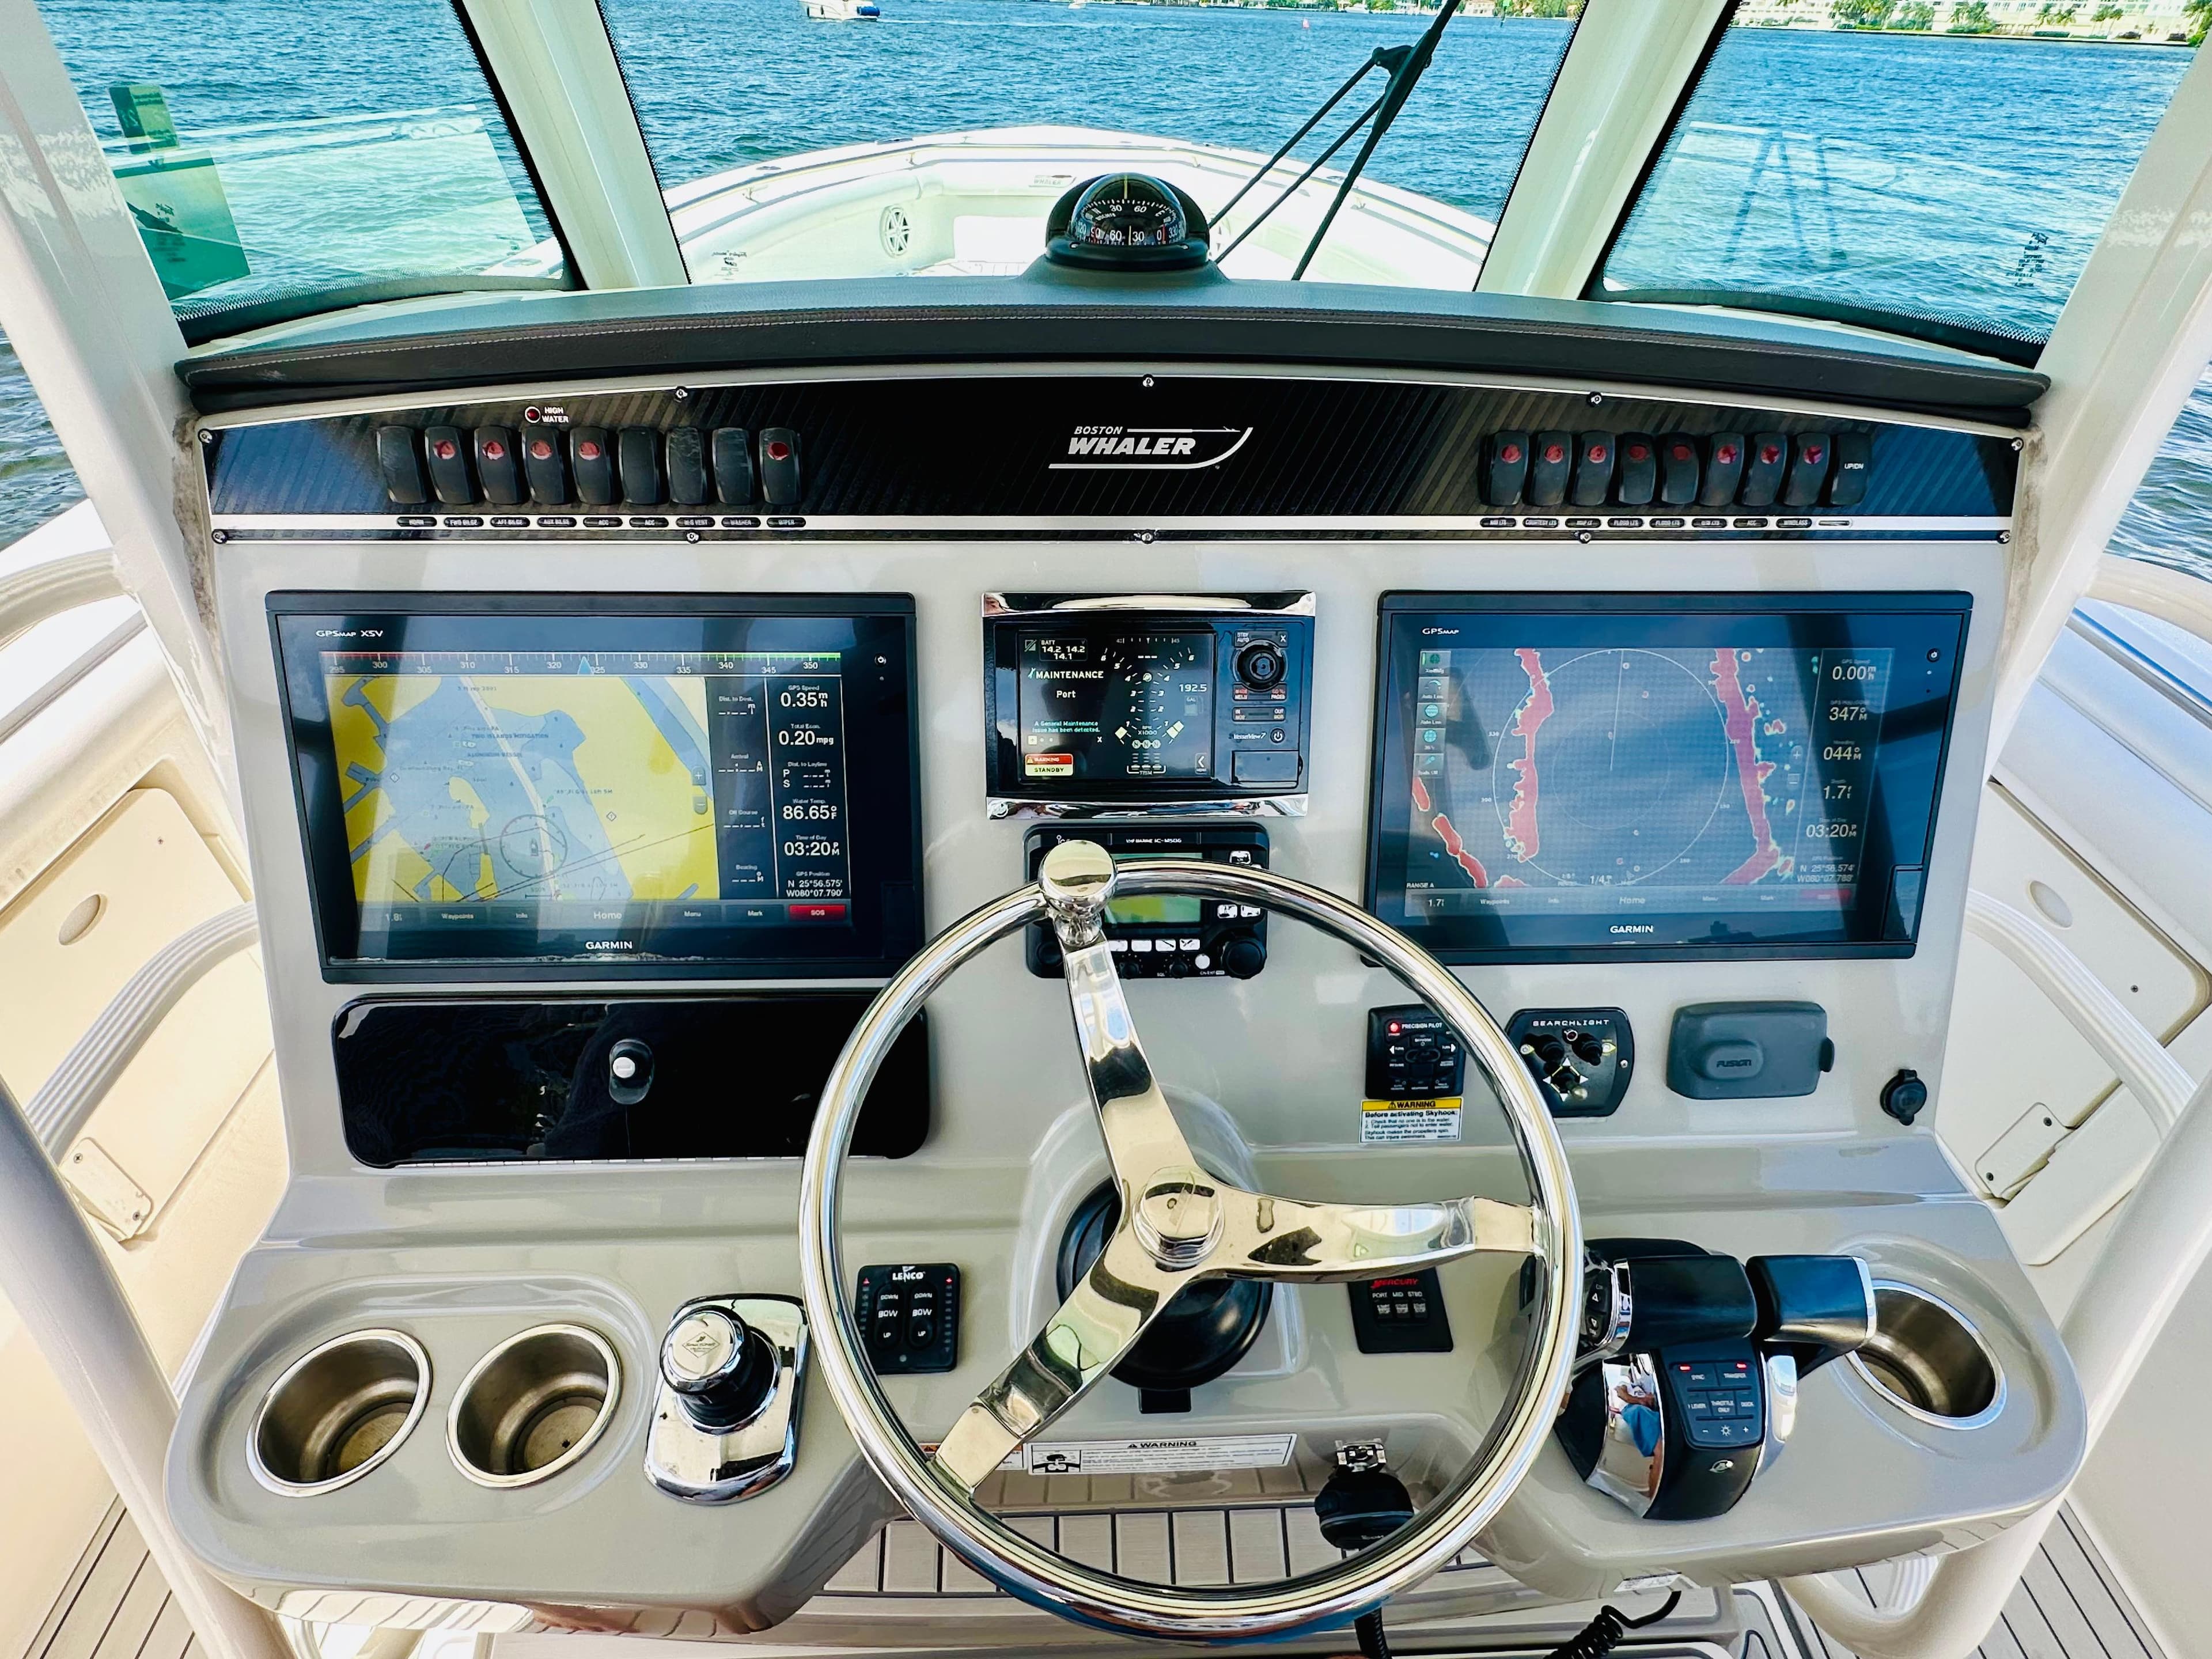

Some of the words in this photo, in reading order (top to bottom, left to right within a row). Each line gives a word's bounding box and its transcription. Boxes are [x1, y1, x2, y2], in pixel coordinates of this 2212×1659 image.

[1109, 230, 1122, 241] 60
[1132, 231, 1145, 241] 30
[544, 406, 564, 414] HIGH
[541, 415, 569, 423] WATER
[1074, 426, 1123, 435] BOSTON
[1068, 437, 1196, 454] WHALER
[372, 661, 388, 669] 300
[505, 666, 520, 674] 315
[1036, 671, 1104, 679] MAINTENANCE
[1832, 666, 1867, 680] 0.00
[1179, 684, 1207, 692] 192.5
[1056, 690, 1076, 698] Port
[781, 692, 818, 707] 0.35
[1829, 707, 1859, 721] 347
[778, 730, 816, 745] 0.20
[816, 736, 834, 745] mpg
[1823, 747, 1852, 760] 044
[783, 769, 790, 777] P
[783, 779, 790, 788] S
[783, 805, 830, 820] 86.65
[1805, 824, 1849, 838] 03:20
[783, 841, 831, 857] 03:20
[787, 880, 795, 888] N
[1619, 896, 1646, 905] Home
[441, 912, 474, 921] Waypoints
[593, 911, 622, 919] Home
[1610, 925, 1654, 933] GARMIN
[585, 941, 632, 950] GARMIN
[1716, 1059, 1752, 1068] FUSION
[892, 1271, 925, 1281] LENCO
[878, 1310, 899, 1319] BOW
[912, 1308, 933, 1317] BOW
